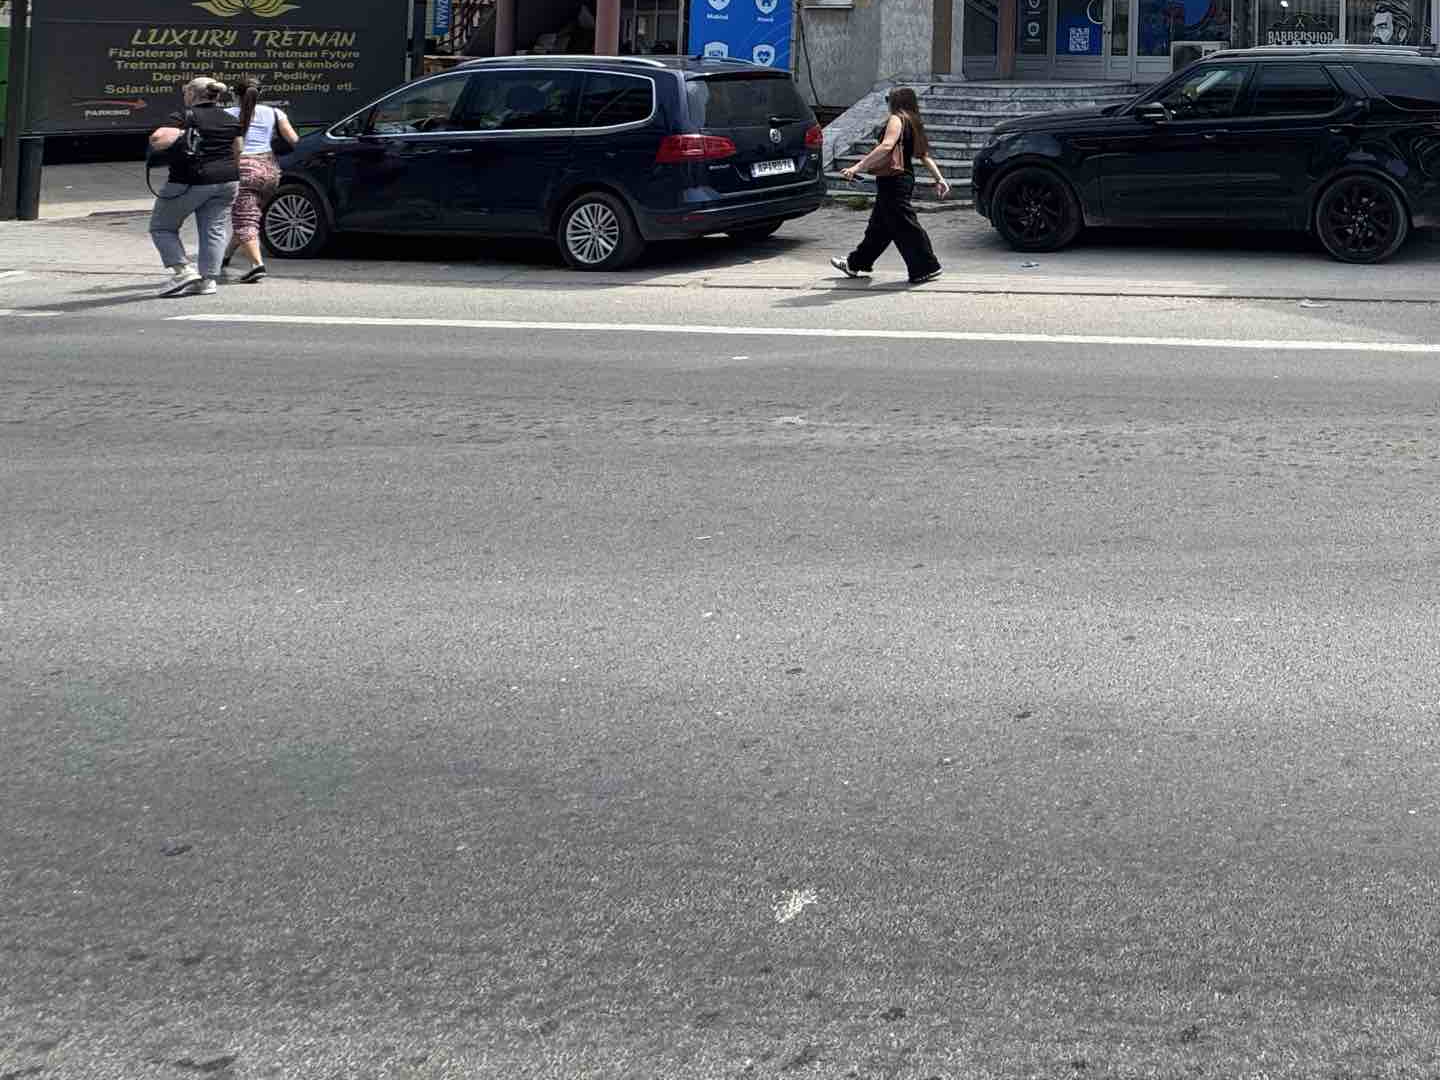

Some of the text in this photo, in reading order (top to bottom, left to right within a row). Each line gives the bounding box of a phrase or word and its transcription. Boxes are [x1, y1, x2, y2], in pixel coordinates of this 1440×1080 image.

[131, 28, 357, 48] LUXURY TRETMAN
[1267, 31, 1335, 44] BARBERSHOP
